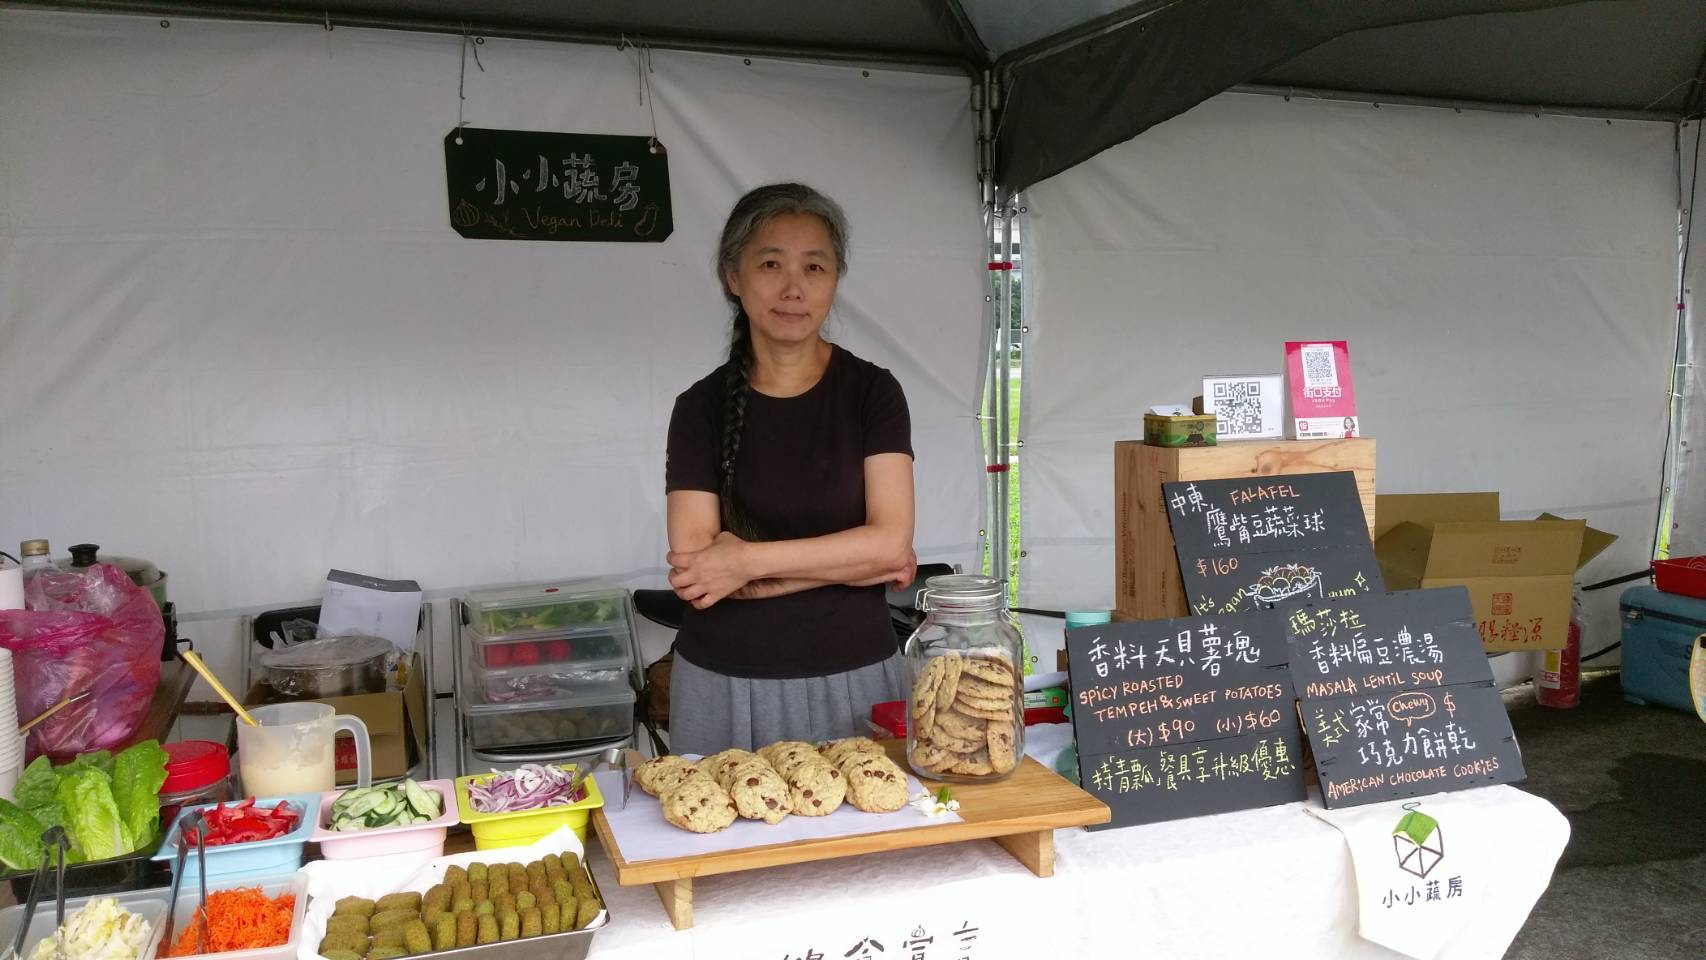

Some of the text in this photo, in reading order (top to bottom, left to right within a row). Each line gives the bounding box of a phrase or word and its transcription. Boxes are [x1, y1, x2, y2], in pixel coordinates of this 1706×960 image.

[475, 152, 641, 211] 小小蔬房
[521, 206, 624, 234] Vegan Deli
[1302, 386, 1343, 399] 街口支付
[1170, 483, 1209, 517] 中東
[1230, 485, 1300, 506] FALAFEL
[1206, 503, 1326, 548] 鷹嘴豆蔬菜球
[1195, 557, 1239, 577] $160
[1193, 594, 1215, 616] It's
[1288, 608, 1366, 638] 瑪莎拉
[1088, 623, 1261, 678] 香料天貝薯塊
[1309, 625, 1444, 674] 香料扁豆濃湯
[1122, 674, 1183, 692] ROASTED
[1224, 684, 1283, 700] POTATOES
[1307, 677, 1358, 698] MASALA
[1411, 669, 1443, 688] SOUP
[1392, 697, 1430, 713] Chewy
[1358, 721, 1476, 768] 巧克力餅乾
[1389, 766, 1447, 786] CHOCOLATE
[1382, 875, 1463, 909] 小小蔬房
